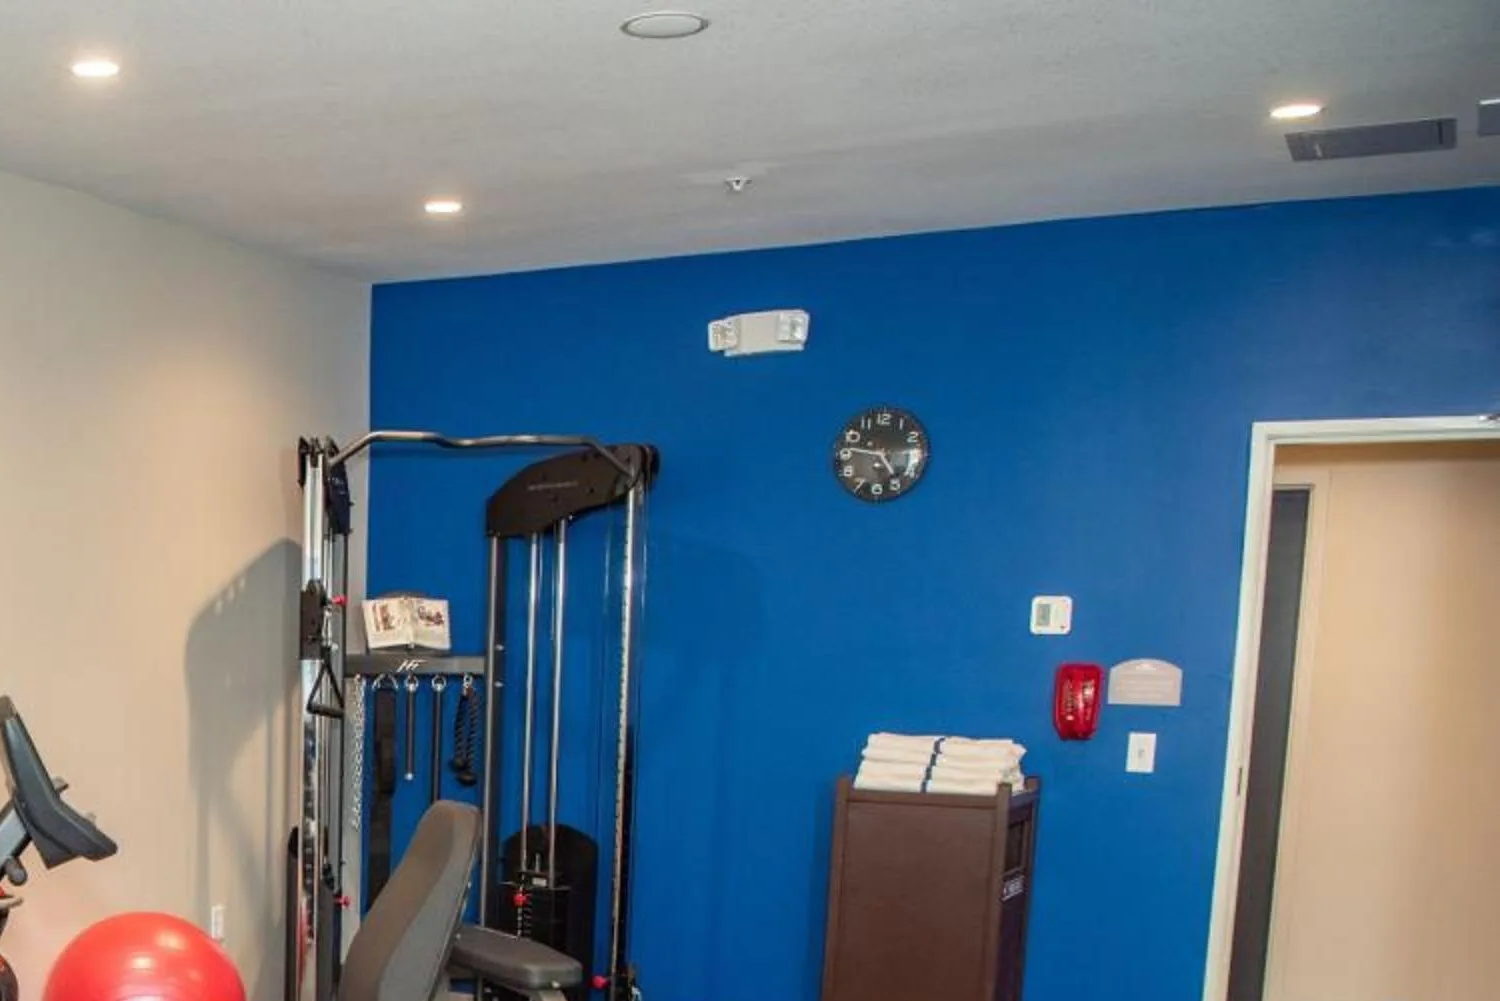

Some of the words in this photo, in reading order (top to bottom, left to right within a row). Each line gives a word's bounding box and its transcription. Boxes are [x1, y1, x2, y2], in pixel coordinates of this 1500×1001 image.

[861, 416, 872, 430] 11
[876, 413, 891, 425] 12
[907, 431, 919, 443] 2
[871, 483, 883, 496] 6
